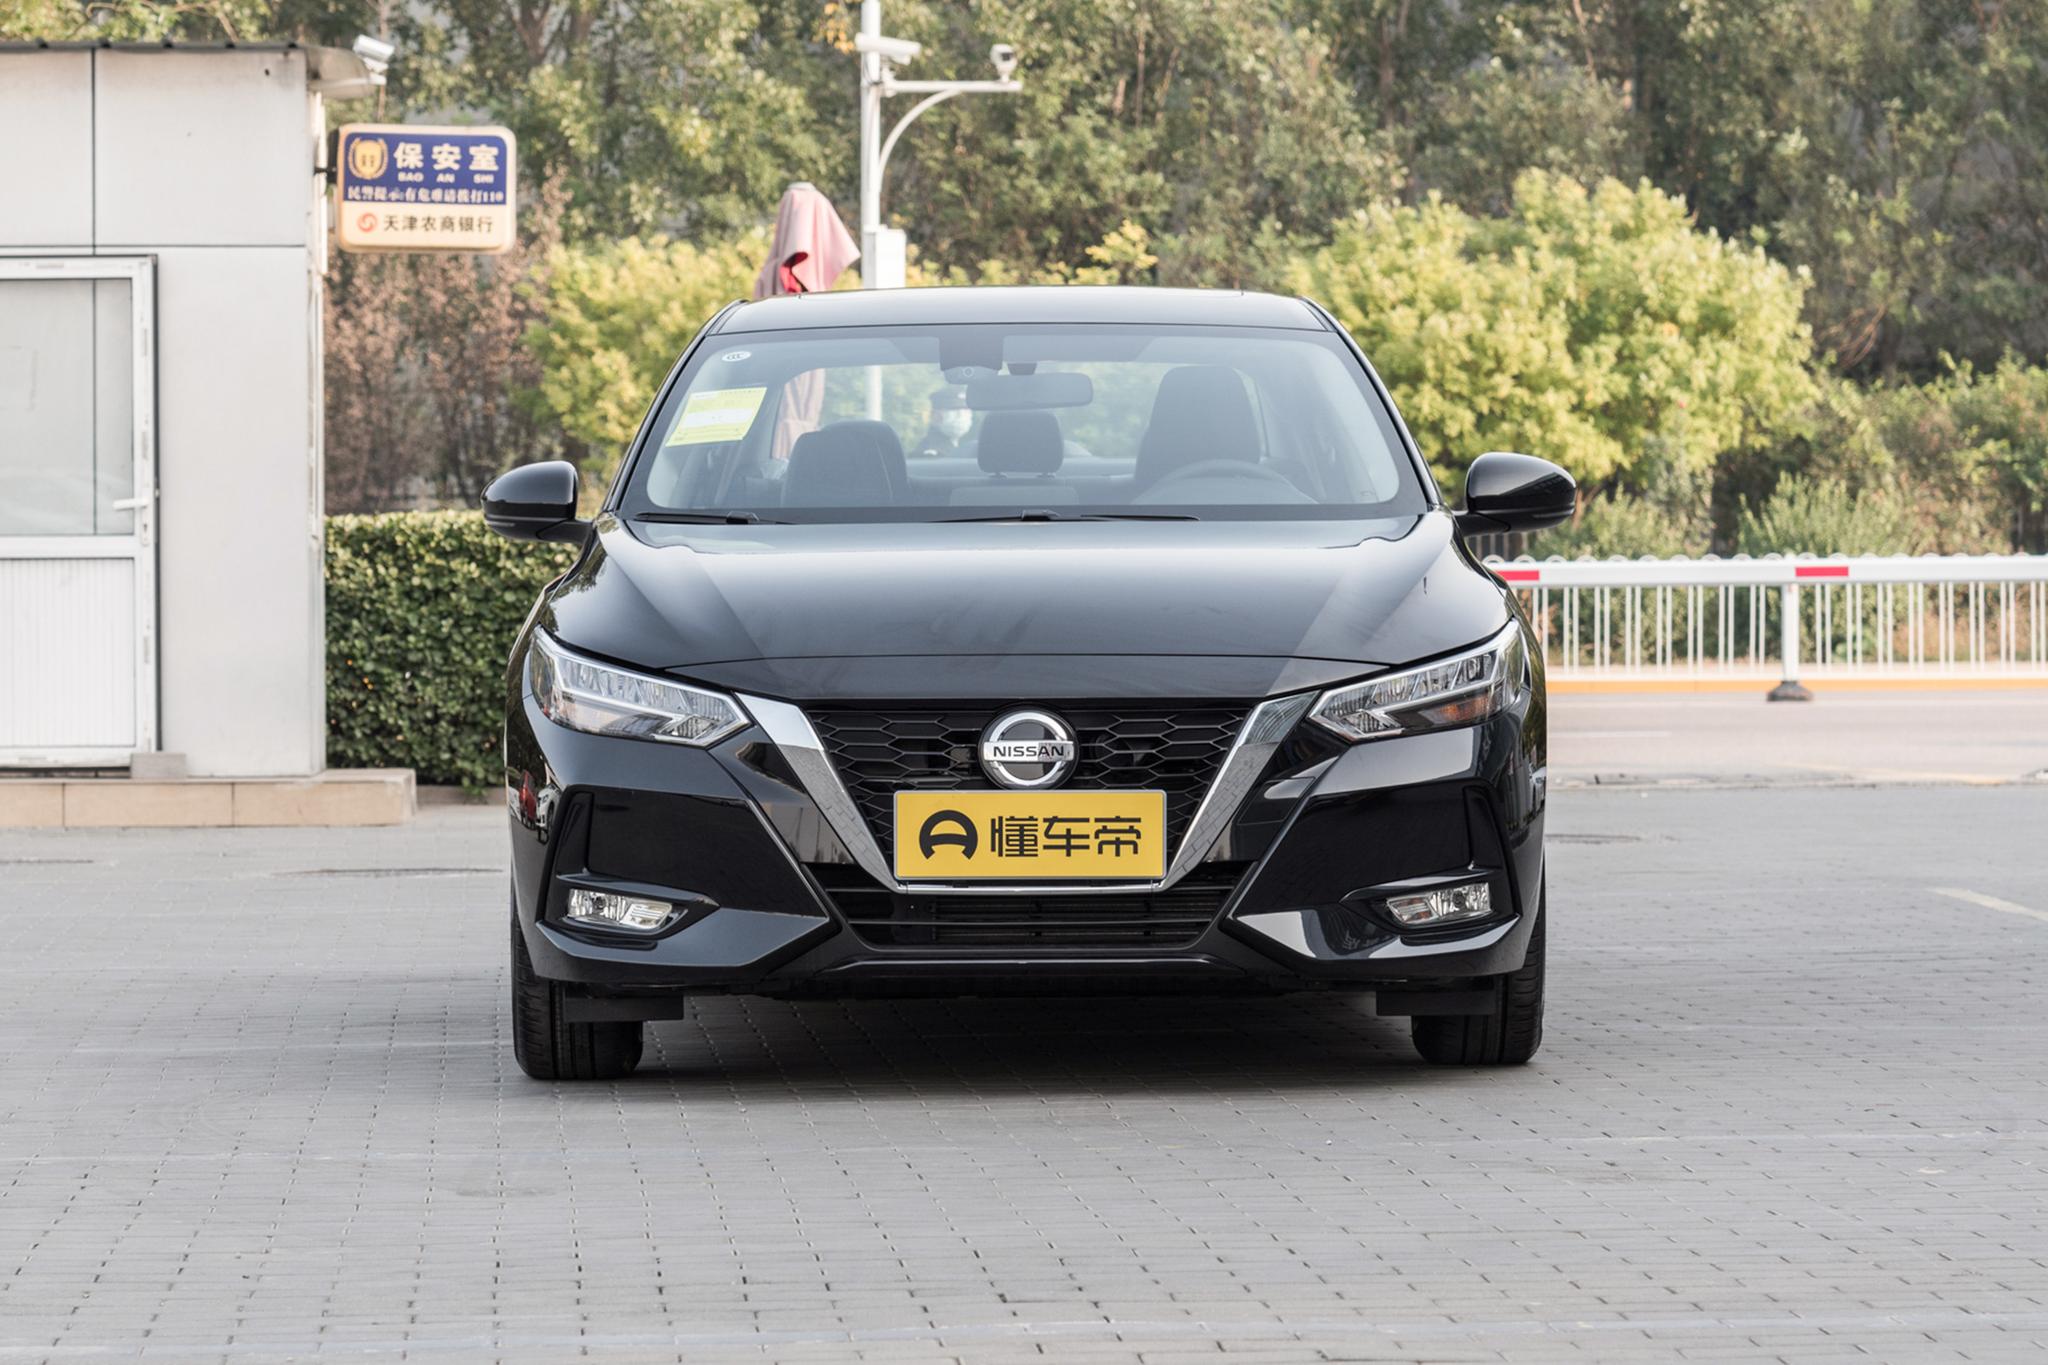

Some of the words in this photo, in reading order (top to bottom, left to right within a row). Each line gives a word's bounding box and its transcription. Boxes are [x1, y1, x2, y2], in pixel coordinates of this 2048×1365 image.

[393, 142, 499, 171] 保安室
[398, 172, 424, 182] BAO
[436, 174, 455, 184] AN
[473, 174, 495, 184] SHI
[384, 216, 493, 232] 天津农商银行
[993, 745, 1064, 758] NISSAN
[990, 816, 1141, 857] 懂车帝
